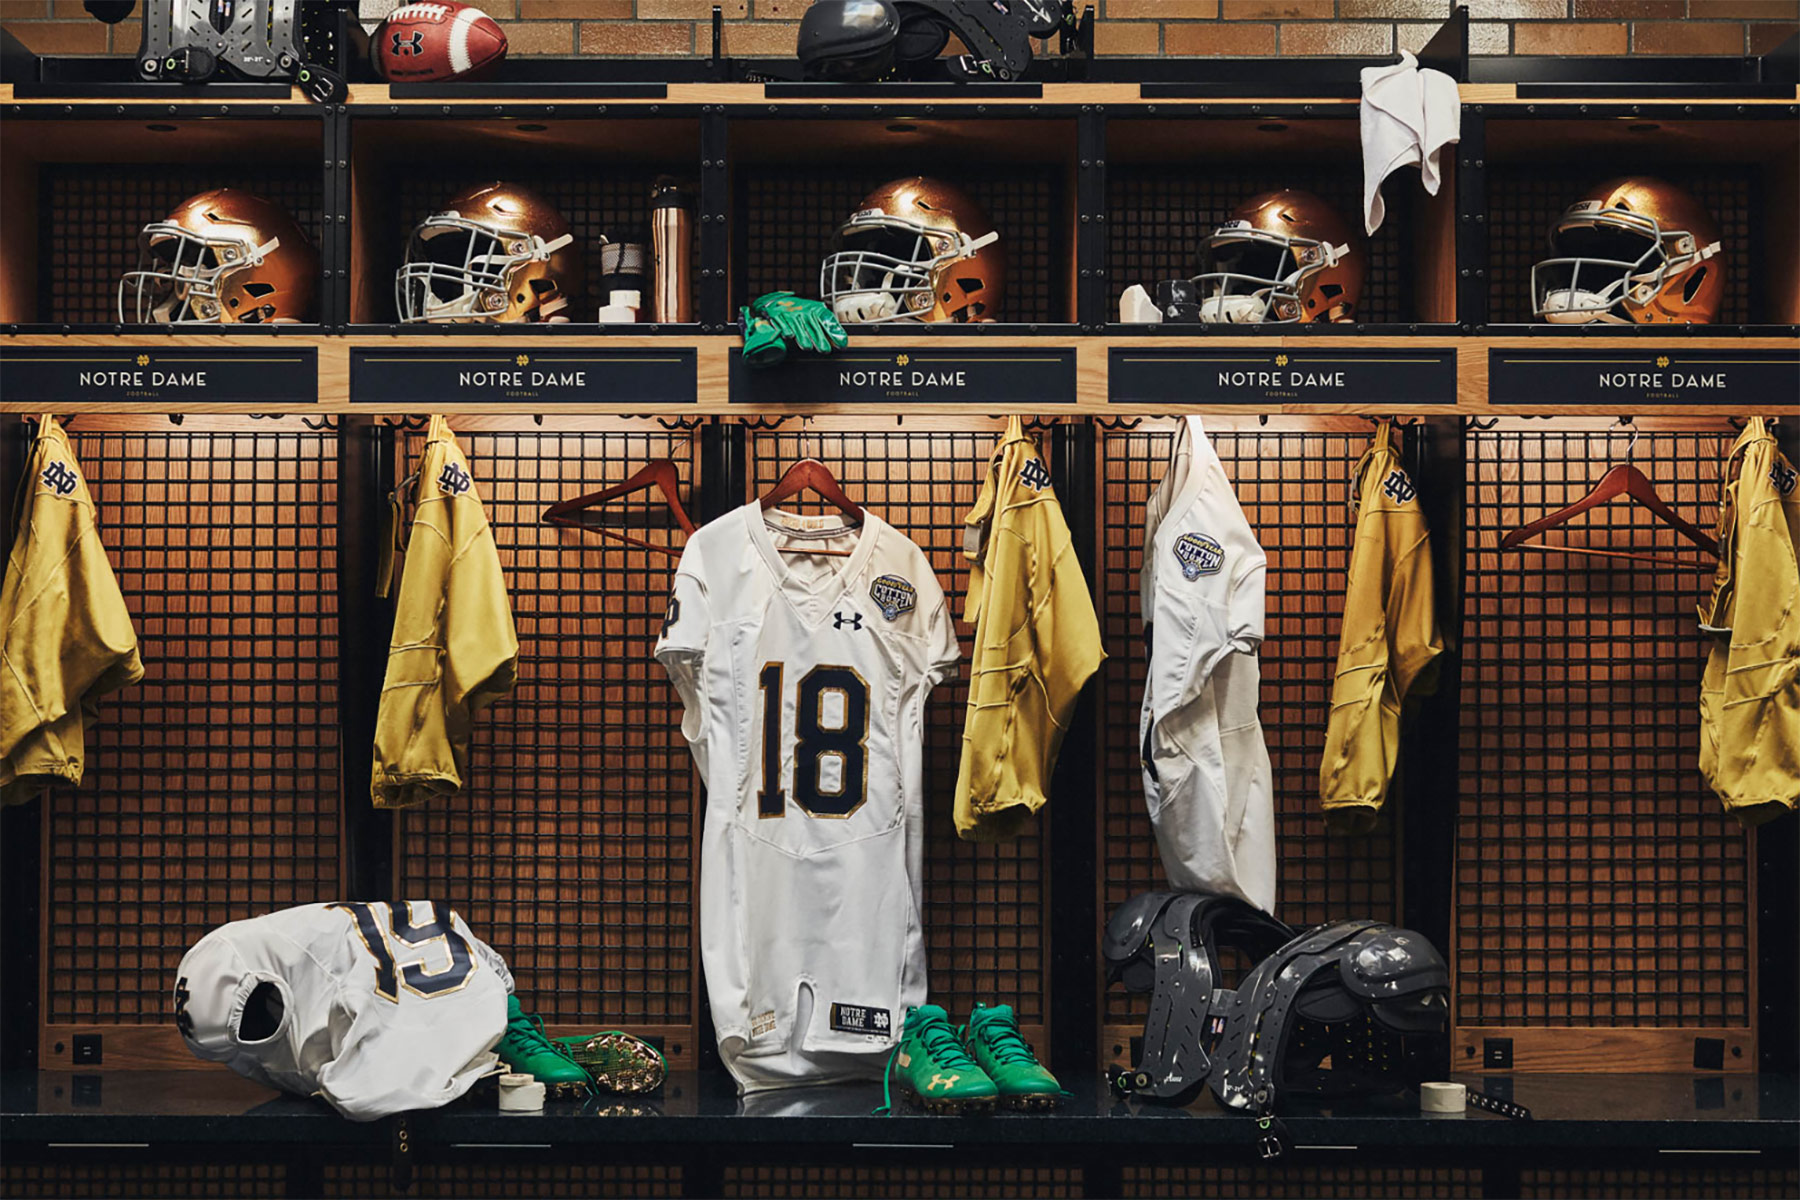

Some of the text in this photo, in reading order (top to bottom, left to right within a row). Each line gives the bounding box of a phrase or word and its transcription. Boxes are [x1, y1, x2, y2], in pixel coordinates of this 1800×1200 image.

[80, 371, 207, 387] NOTRE DAME
[459, 371, 586, 387] NOTRE DAME
[840, 371, 966, 387] NOTRE DAME
[1218, 371, 1345, 387] NOTRE DAME
[1599, 373, 1726, 388] NOTRE DAME
[1177, 540, 1221, 568] COTTON
[874, 584, 913, 606] COTTON
[757, 661, 871, 819] 18
[840, 1006, 867, 1019] NOTRE
[841, 1015, 865, 1028] DAME
